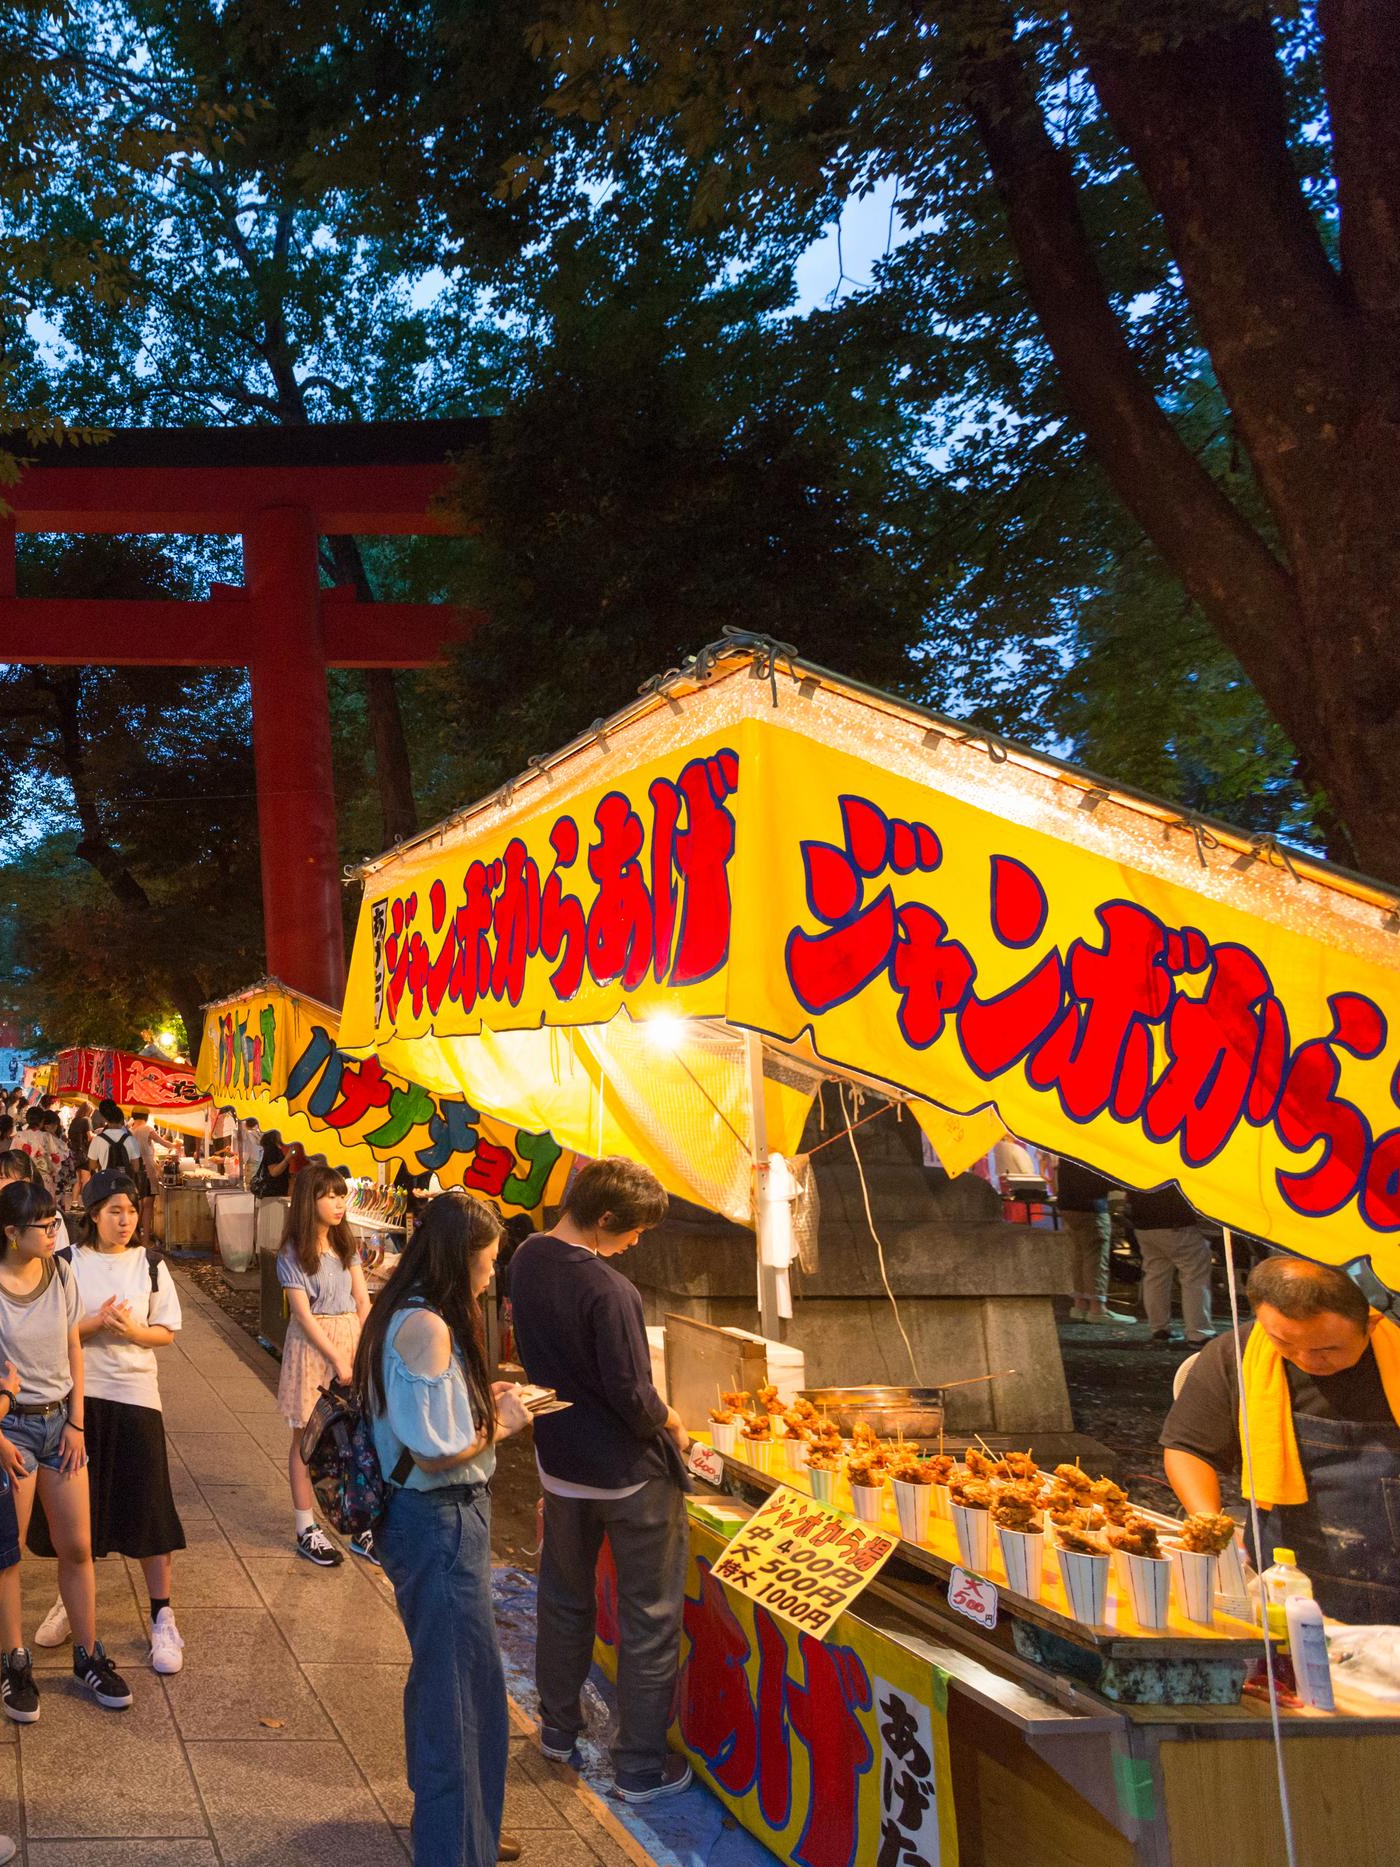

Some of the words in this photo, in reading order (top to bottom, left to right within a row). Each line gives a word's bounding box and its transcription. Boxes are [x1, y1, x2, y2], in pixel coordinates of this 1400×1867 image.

[385, 748, 739, 1026] ジャンボからあげ
[785, 794, 1400, 1233] ジャンボから
[747, 1525, 774, 1542] 中
[776, 1538, 864, 1589] 400円
[759, 1494, 893, 1572] ジャンボから揚
[715, 1559, 758, 1589] 特大
[755, 1583, 832, 1630] 1000円
[730, 1543, 761, 1563] 大
[759, 1558, 847, 1608] 500円
